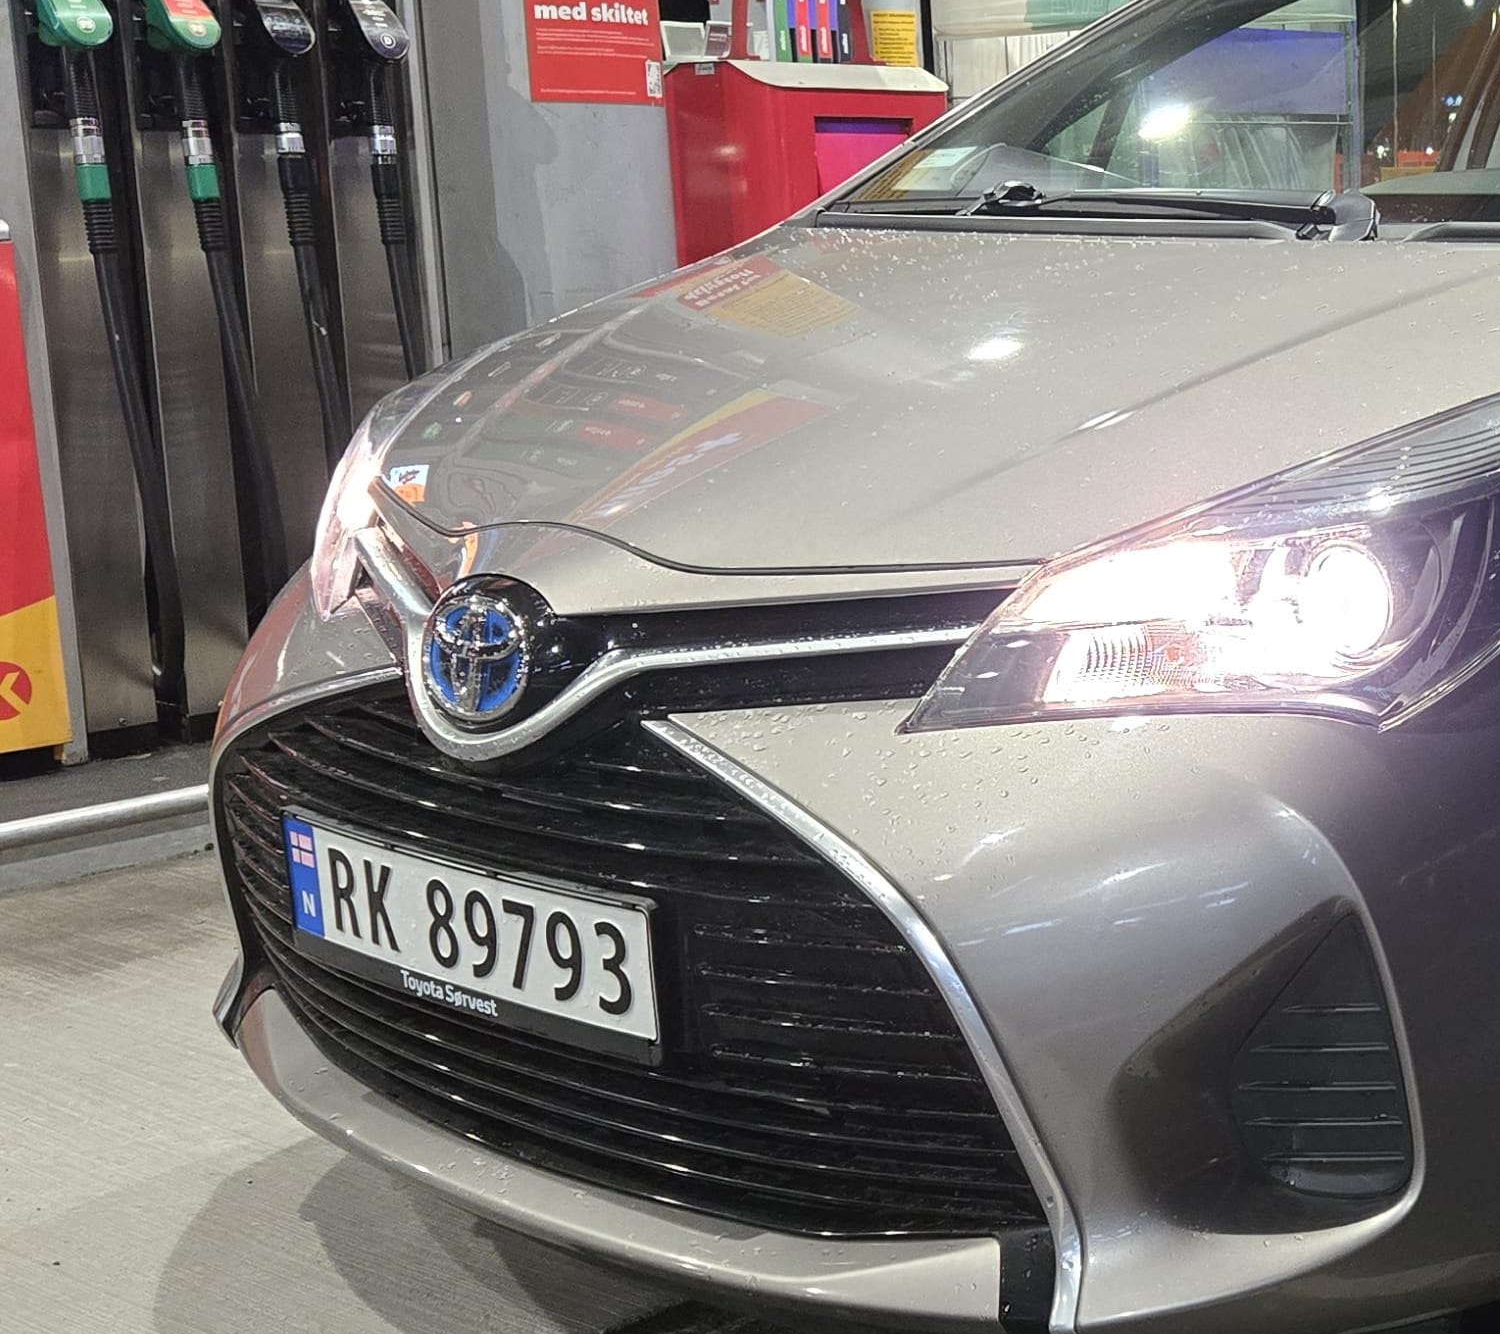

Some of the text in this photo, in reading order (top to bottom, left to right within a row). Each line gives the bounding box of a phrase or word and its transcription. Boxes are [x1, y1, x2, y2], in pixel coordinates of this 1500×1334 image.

[533, 1, 649, 26] med skiltet
[302, 890, 317, 916] N
[327, 848, 632, 1016] RK 89793
[401, 970, 498, 1017] Toyota Sørvest
